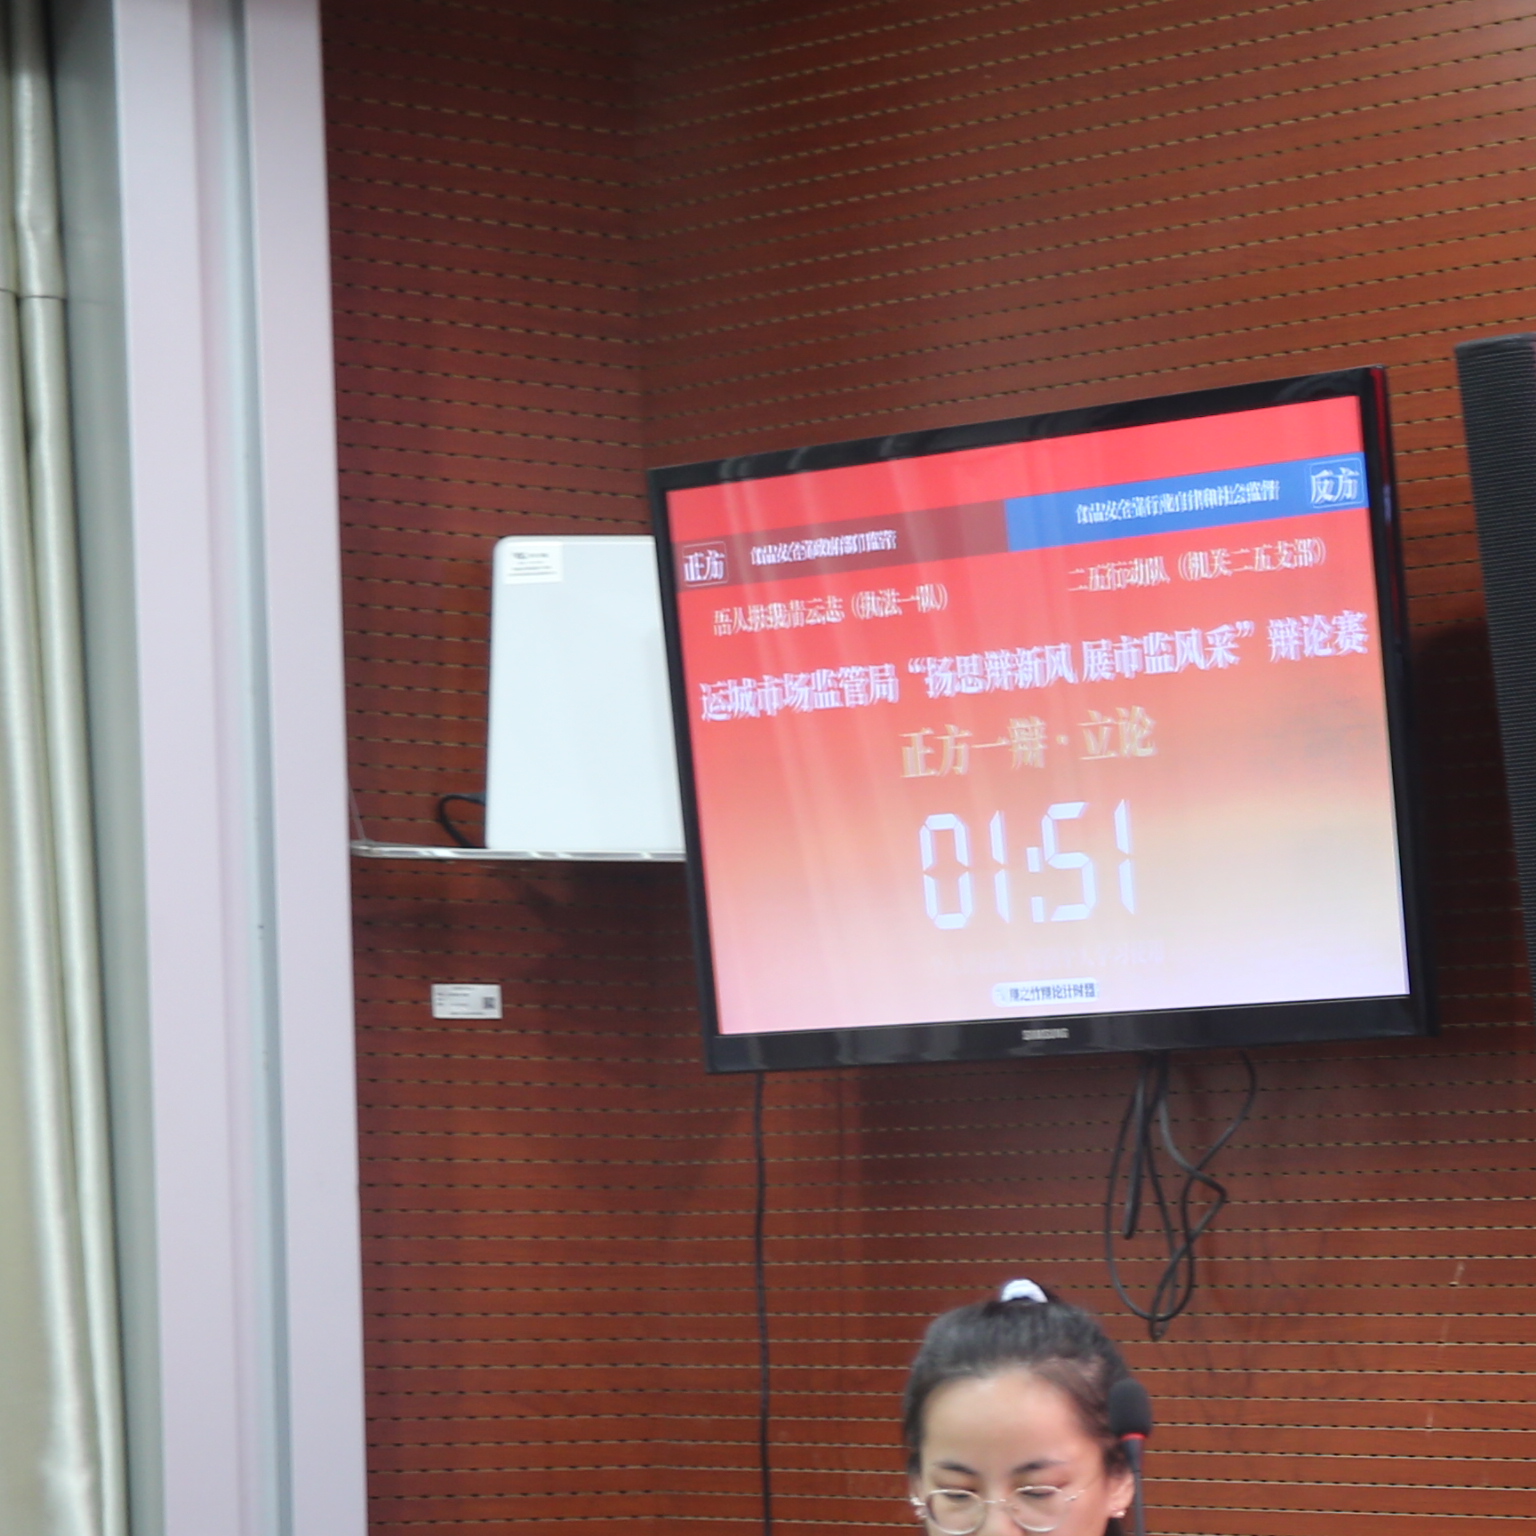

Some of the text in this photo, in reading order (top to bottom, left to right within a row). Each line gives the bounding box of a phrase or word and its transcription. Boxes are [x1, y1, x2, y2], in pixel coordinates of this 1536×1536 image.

[1310, 467, 1360, 504] 反方
[683, 549, 726, 582] 正方
[919, 798, 1137, 930] 01:51
